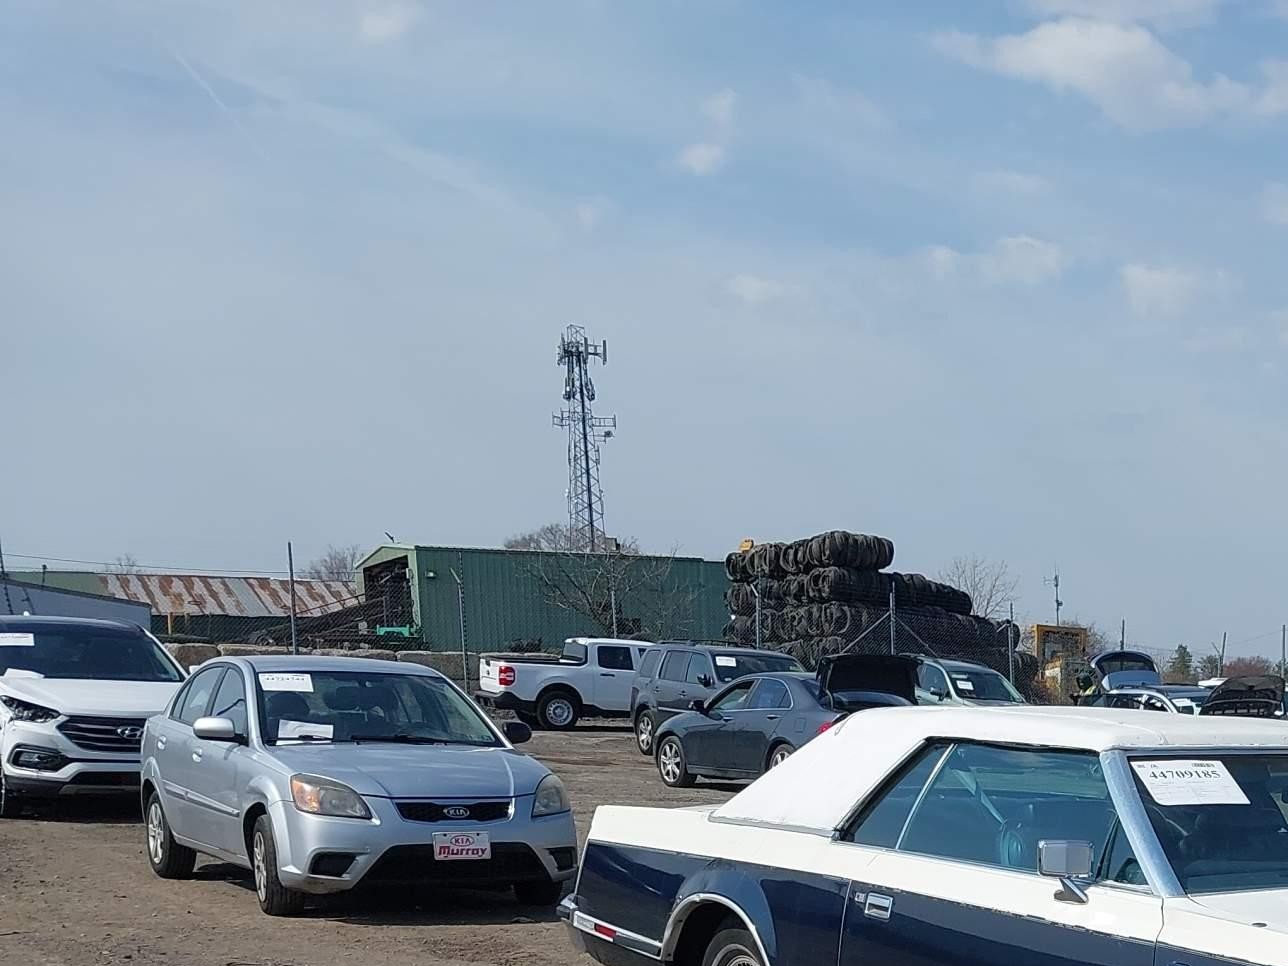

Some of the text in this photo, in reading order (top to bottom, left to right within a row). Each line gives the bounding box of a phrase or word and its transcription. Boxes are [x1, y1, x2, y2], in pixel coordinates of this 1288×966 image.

[1149, 770, 1221, 779] 44709185
[449, 808, 467, 816] KIA
[454, 837, 472, 845] KIA
[439, 846, 487, 857] Murray
